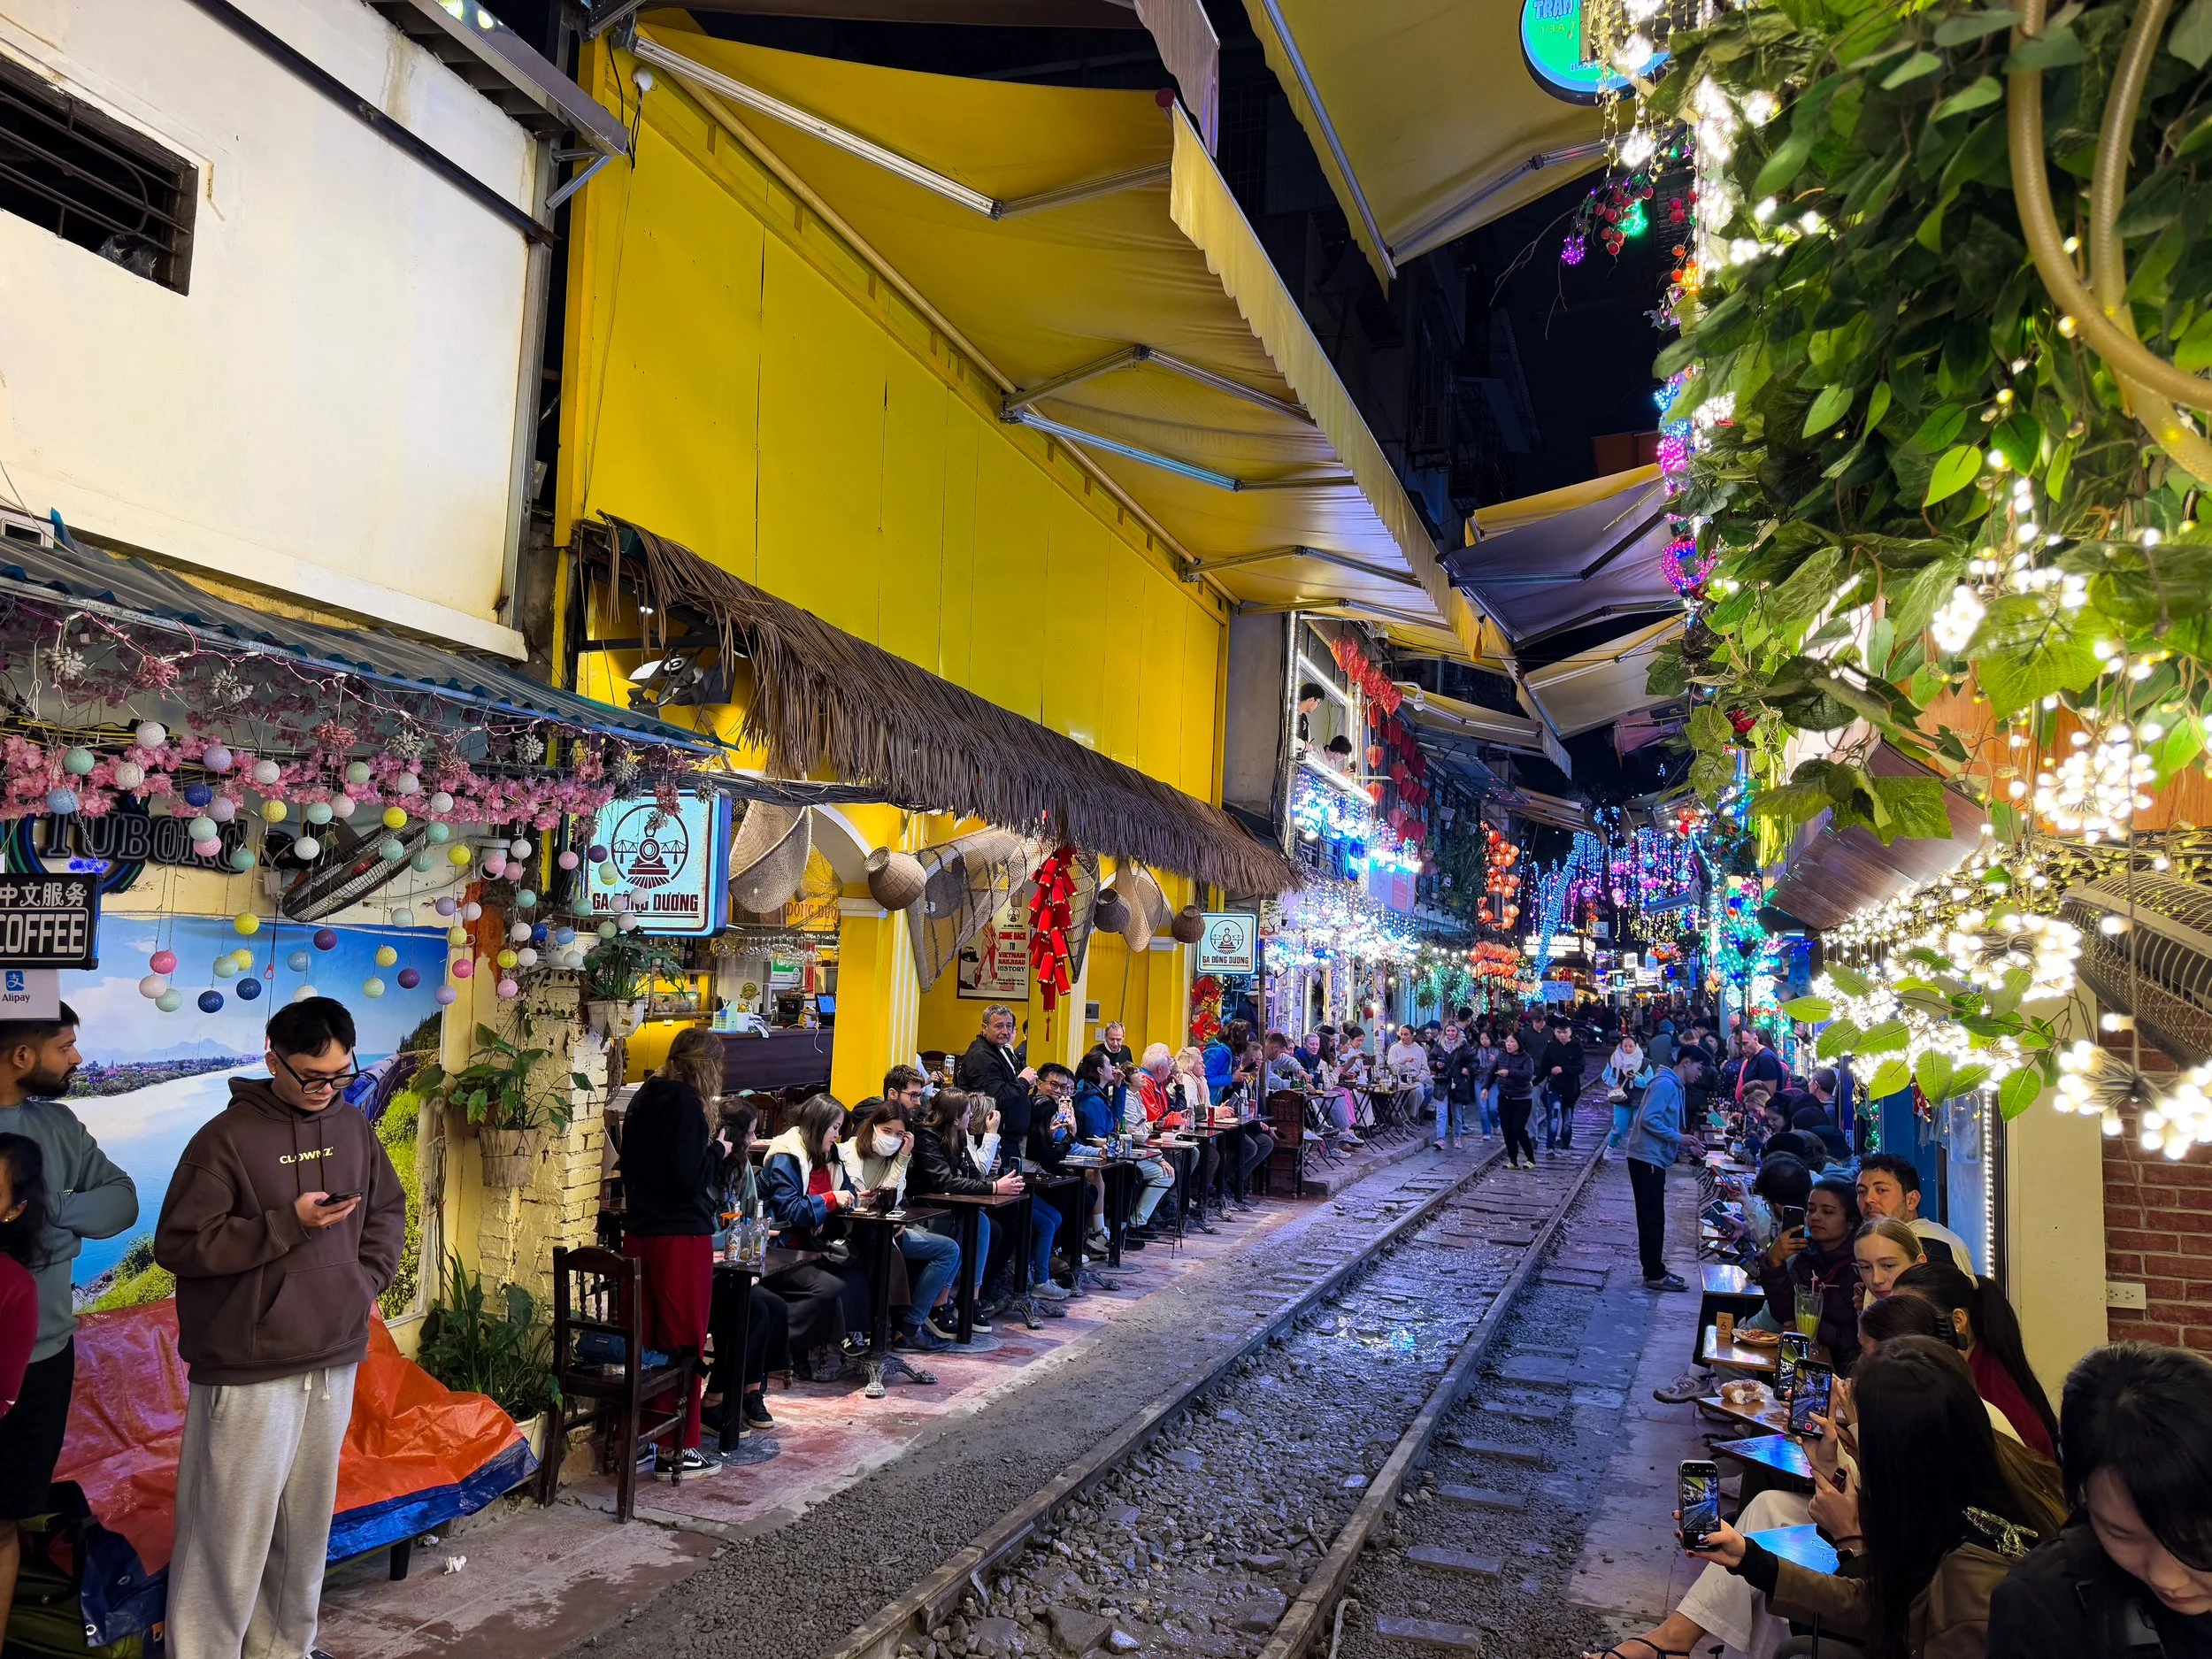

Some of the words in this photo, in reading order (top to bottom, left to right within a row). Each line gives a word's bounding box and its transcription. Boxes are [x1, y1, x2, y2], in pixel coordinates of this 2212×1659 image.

[0, 882, 88, 907] 中文服务
[592, 893, 610, 910] GA
[653, 891, 699, 911] DƯƠNG
[2, 993, 30, 1003] Alipay
